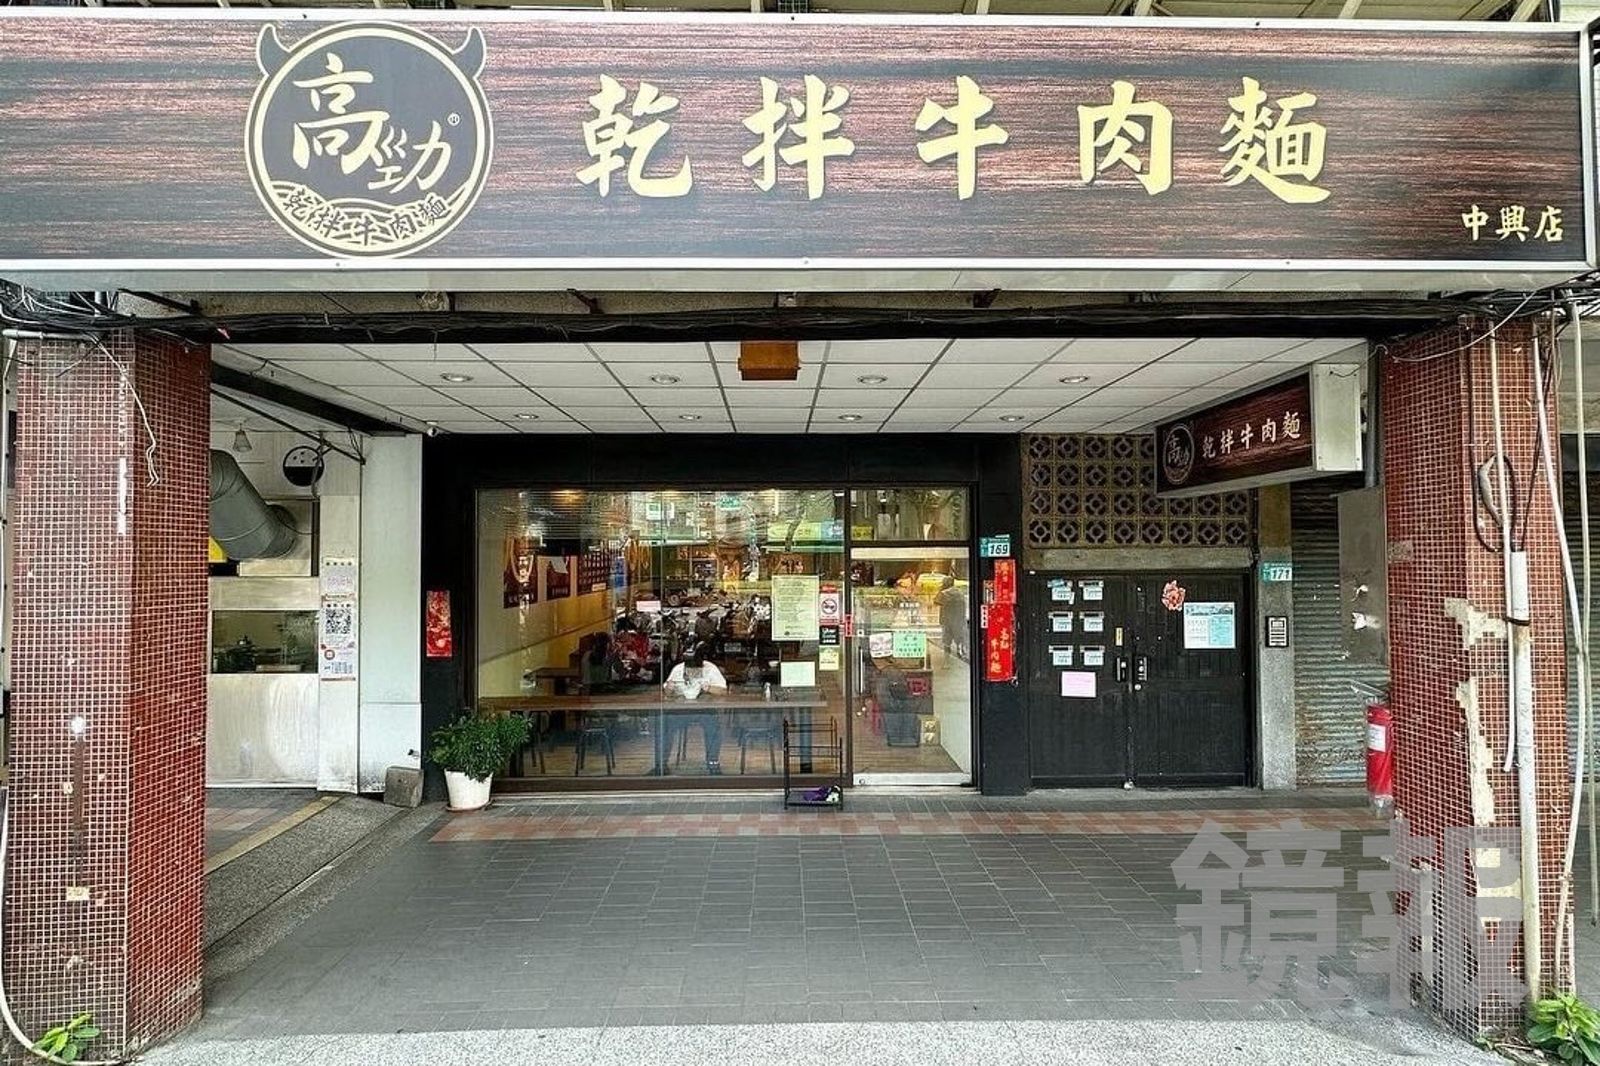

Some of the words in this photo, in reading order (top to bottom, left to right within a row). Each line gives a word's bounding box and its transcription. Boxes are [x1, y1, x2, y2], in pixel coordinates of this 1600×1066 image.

[292, 52, 452, 194] 高勁
[575, 74, 1332, 204] 乾拌牛肉麵
[282, 191, 450, 247] 乾拌牛肉麵
[1461, 204, 1564, 242] 中興店
[1202, 411, 1301, 459] 乾拌牛肉麵
[989, 543, 1008, 555] 169
